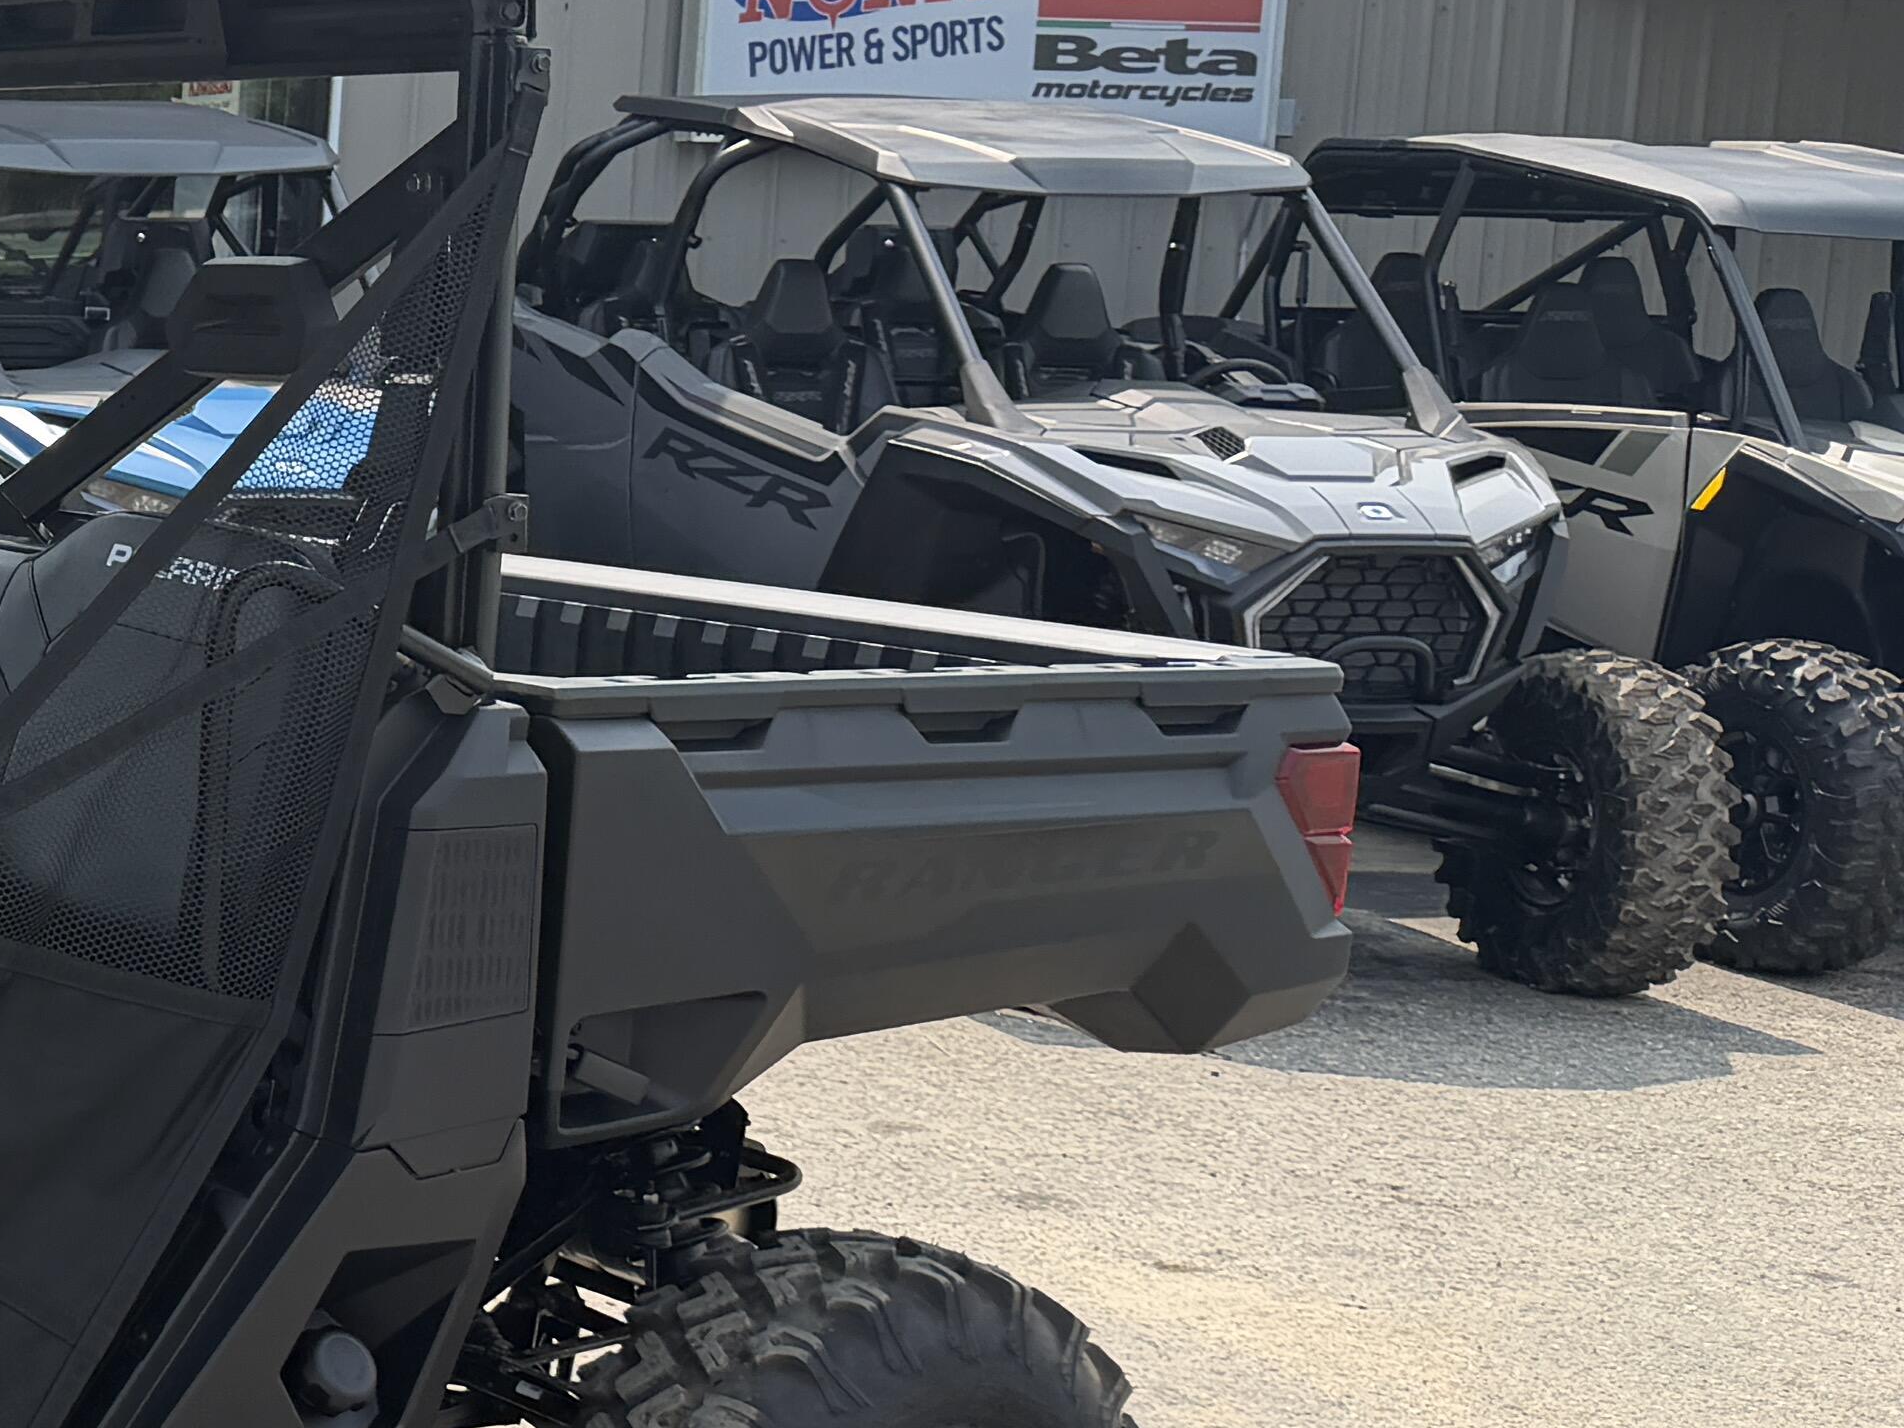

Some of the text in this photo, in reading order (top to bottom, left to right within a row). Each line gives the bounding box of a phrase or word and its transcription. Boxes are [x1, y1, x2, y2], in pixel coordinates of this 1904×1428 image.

[748, 15, 1005, 78] POWER & SPORTS
[1033, 34, 1257, 77] Beta
[1032, 80, 1254, 107] motorcycles
[642, 427, 833, 530] RZR
